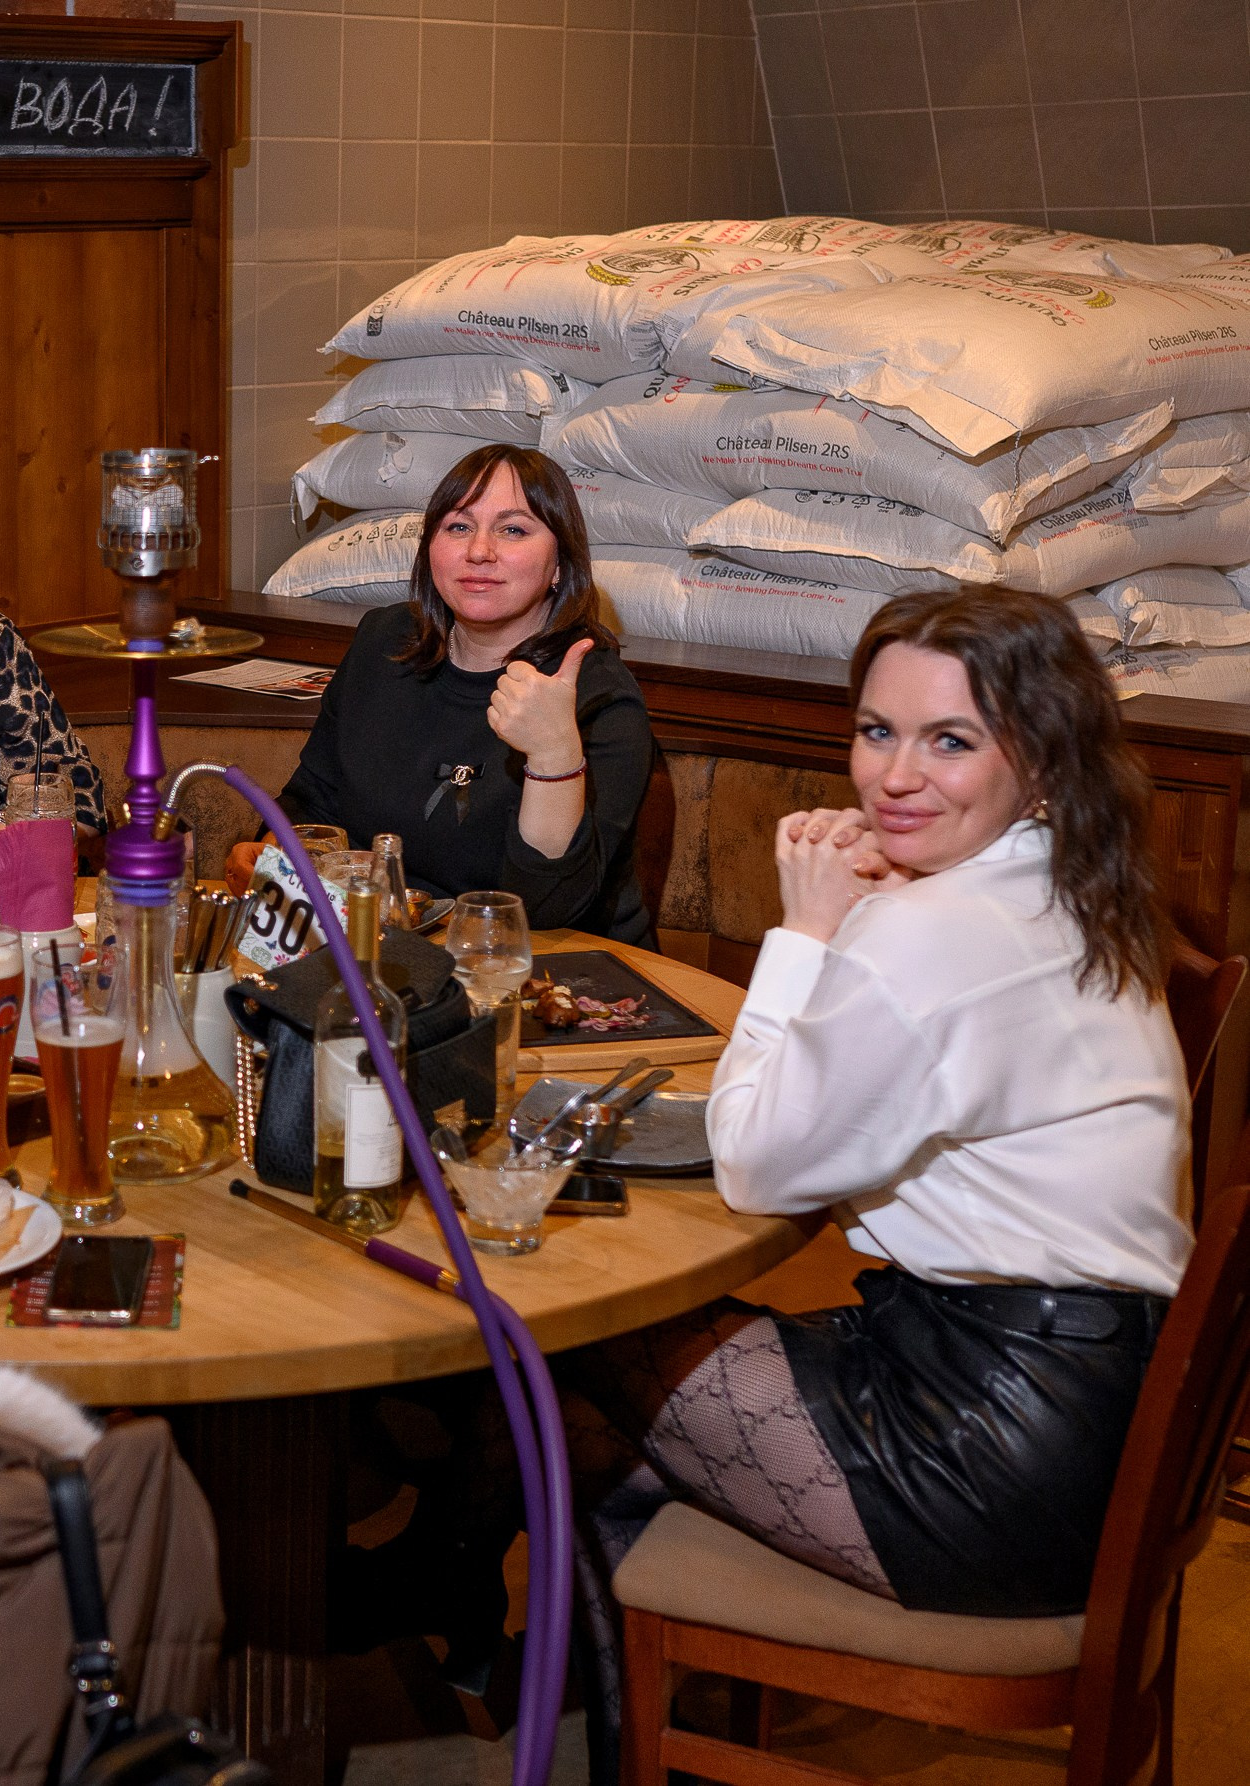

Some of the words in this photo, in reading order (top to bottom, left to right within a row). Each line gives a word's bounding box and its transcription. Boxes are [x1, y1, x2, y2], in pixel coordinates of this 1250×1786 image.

[458, 310, 514, 328] Château
[518, 316, 559, 336] Pilsen
[562, 323, 588, 338] 2RS
[1148, 335, 1190, 351] Château
[1189, 329, 1218, 342] Pilsen
[1217, 326, 1237, 339] 2RS
[775, 436, 818, 455] Pilsen
[821, 442, 851, 460] 2RS
[702, 455, 715, 464] We
[716, 456, 736, 465] Make
[738, 456, 755, 464] Your
[787, 459, 817, 471] Dreams
[820, 464, 843, 474] Come
[1040, 508, 1087, 530] Château
[1083, 496, 1117, 519] Pilsen
[701, 564, 760, 582] Château
[681, 578, 692, 586] We
[715, 583, 734, 591] Your
[735, 585, 768, 596] Brewing
[768, 587, 799, 597] Dreams
[800, 591, 824, 600] Come
[250, 880, 314, 956] 30
